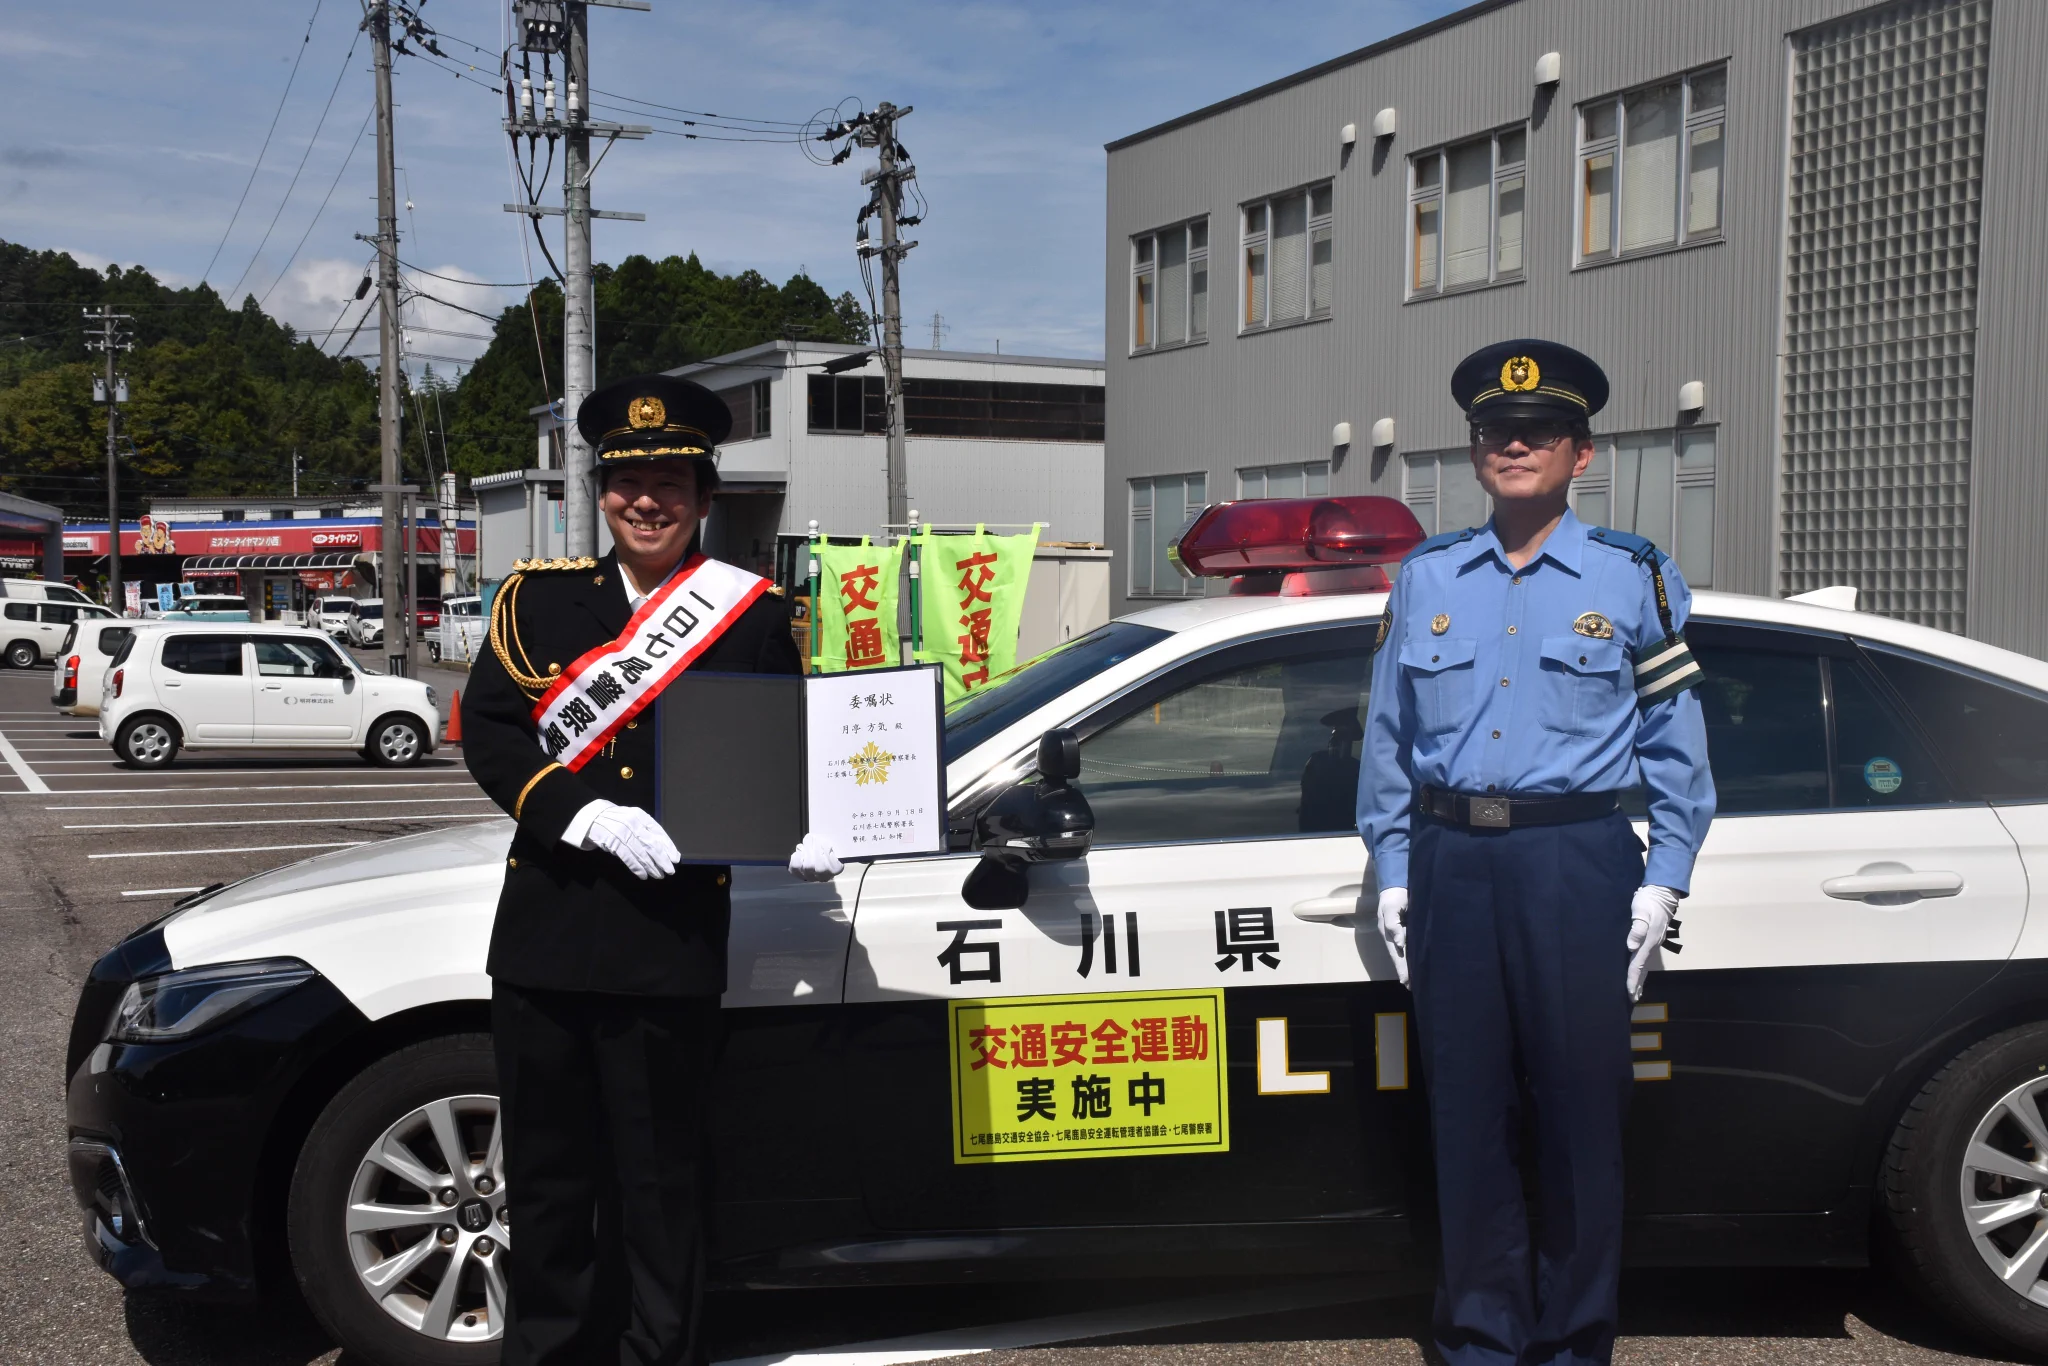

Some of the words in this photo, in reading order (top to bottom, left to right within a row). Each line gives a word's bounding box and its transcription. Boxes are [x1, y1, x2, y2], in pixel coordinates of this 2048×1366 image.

[328, 534, 359, 544] タイヤマン
[1, 561, 35, 570] TYRES
[1655, 574, 1667, 607] POLICE
[841, 564, 886, 671] 交通
[968, 1014, 1209, 1071] 交通安全運動
[1016, 1071, 1166, 1123] 実施中
